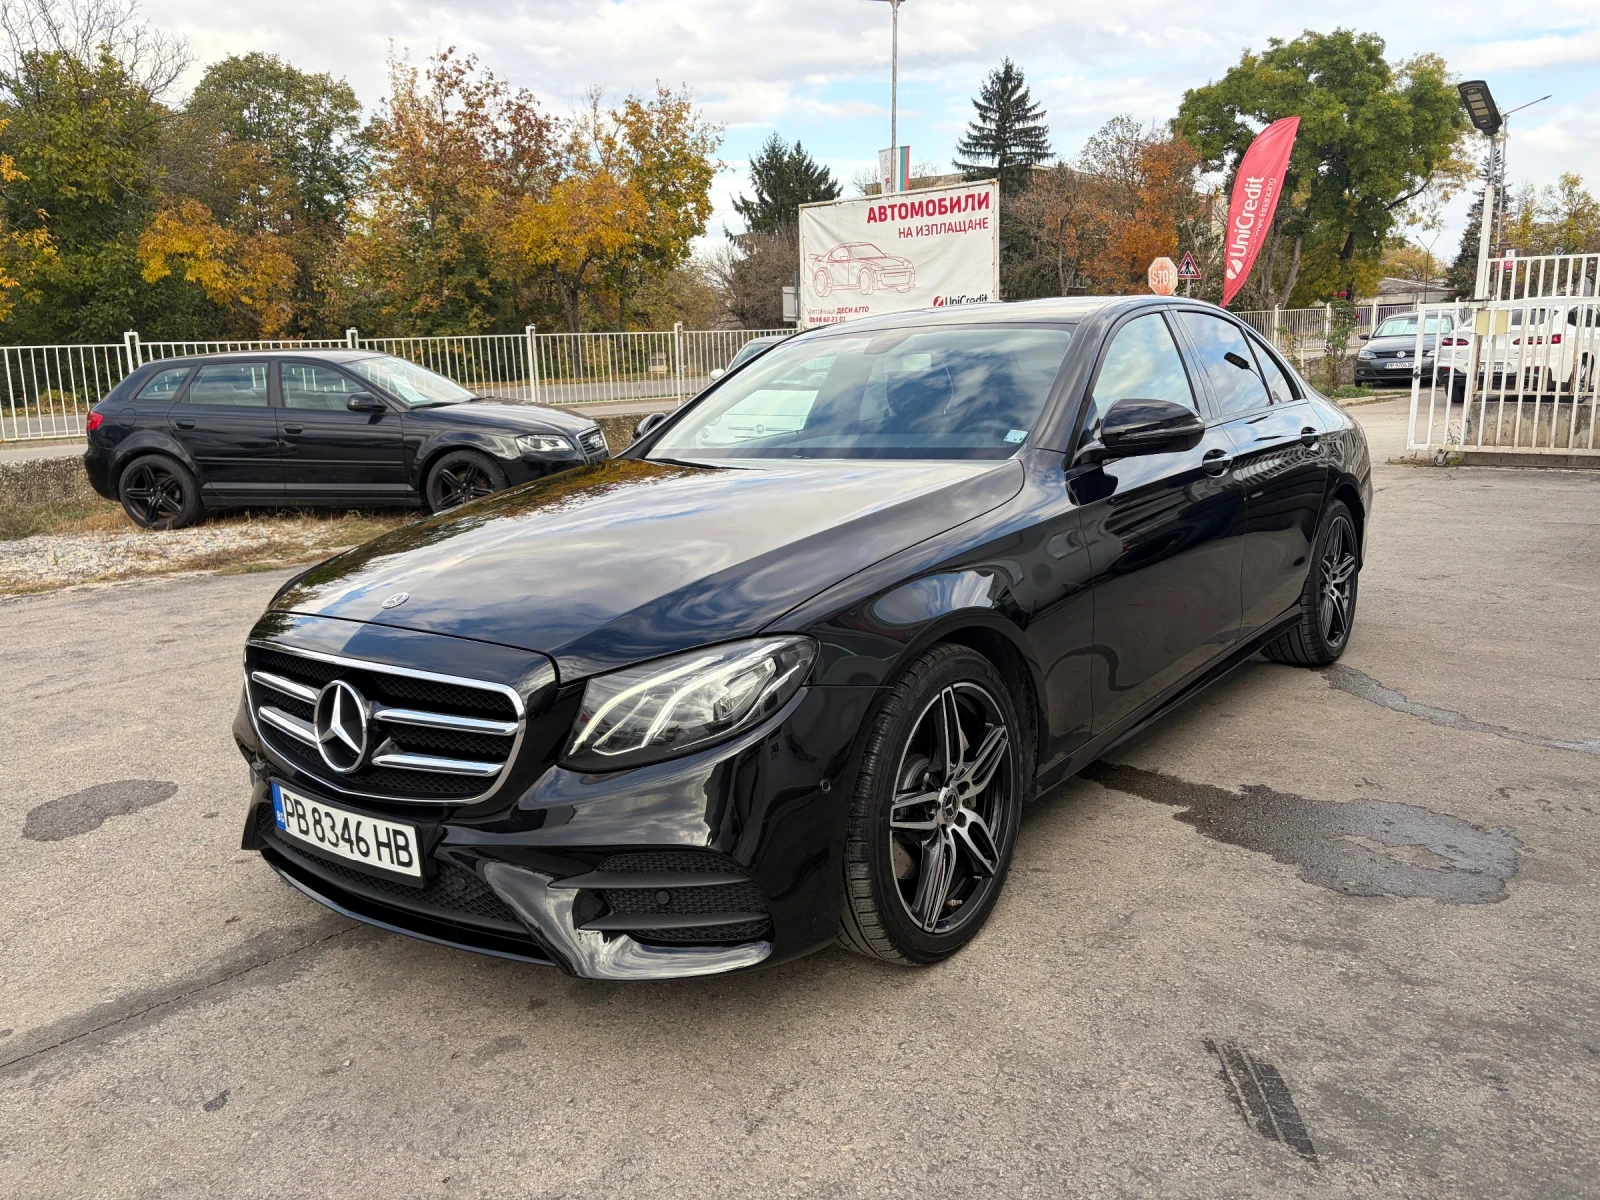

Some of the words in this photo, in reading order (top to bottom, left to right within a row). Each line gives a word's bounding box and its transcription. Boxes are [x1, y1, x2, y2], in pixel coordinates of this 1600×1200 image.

[867, 191, 990, 224] АВТОМОБИЛИ
[1258, 178, 1277, 217] Financing
[898, 227, 914, 239] НА
[916, 216, 989, 238] ИЗПЛАЩАНЕ
[1229, 176, 1265, 258] UniCredit
[1152, 270, 1175, 285] STOP
[944, 293, 988, 306] UniCredit
[283, 793, 310, 836] PB
[312, 807, 370, 858] 8346
[373, 824, 413, 868] HB
